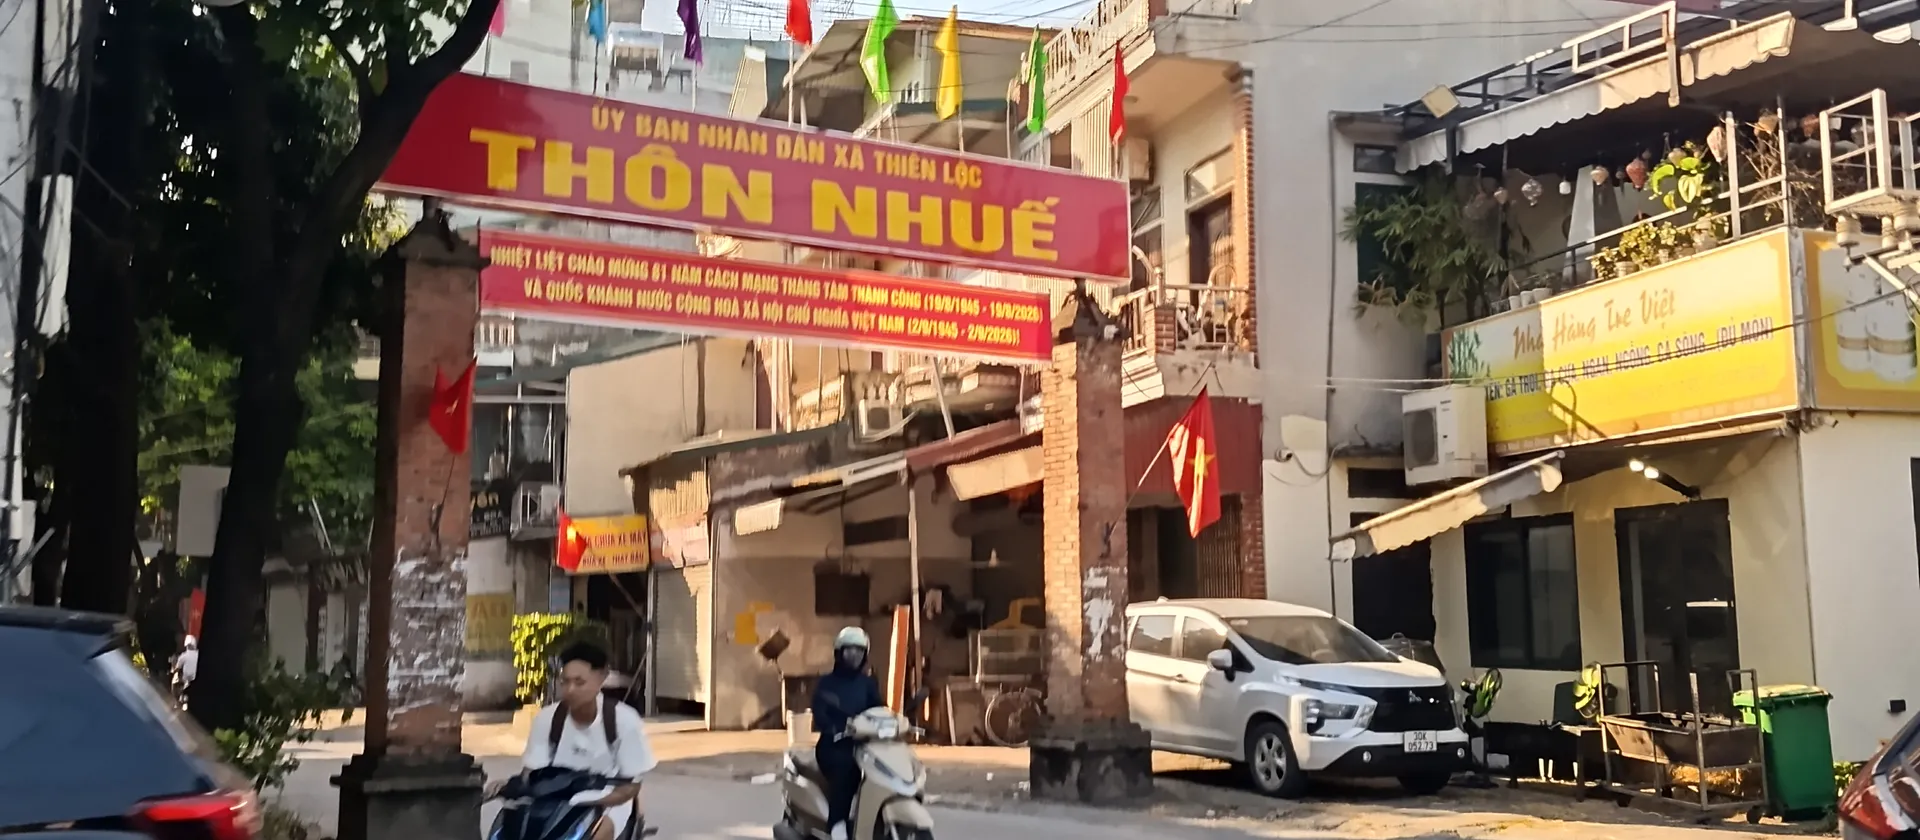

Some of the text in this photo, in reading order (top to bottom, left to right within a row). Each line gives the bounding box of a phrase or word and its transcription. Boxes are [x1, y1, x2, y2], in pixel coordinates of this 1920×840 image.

[636, 113, 689, 144] BAN
[698, 122, 767, 156] NHÂN
[775, 131, 825, 164] DÂN
[874, 150, 937, 183] THIÊN
[943, 160, 982, 190] LỘC
[469, 128, 1060, 261] THÔN NHUẾ
[491, 244, 532, 271] NHIỆT
[536, 247, 564, 275] LIỆT
[568, 253, 604, 277] CHÀO
[608, 255, 649, 281] MỪNG
[671, 263, 701, 285] NĂM
[705, 266, 738, 290] CÁCH
[742, 272, 778, 295] MẠNG
[782, 276, 821, 299] THÁNG
[823, 280, 848, 301] TÁM
[851, 284, 888, 306] THÀNH
[891, 288, 921, 310] CÔNG
[524, 275, 542, 299] VÀ
[546, 276, 583, 304] QUỐC
[587, 283, 633, 308] KHÁNH
[636, 288, 672, 312] NƯỚC
[676, 291, 711, 317] CỘNG
[762, 300, 783, 326] HỘI
[786, 302, 810, 325] CHỦ
[813, 306, 849, 328] NGHĨA
[851, 310, 876, 333] VIỆT
[878, 315, 904, 333] NAM
[1553, 312, 1596, 352] Hàng
[1604, 299, 1631, 332] Tre
[1640, 287, 1676, 330] Việt
[1413, 731, 1427, 741] 30K
